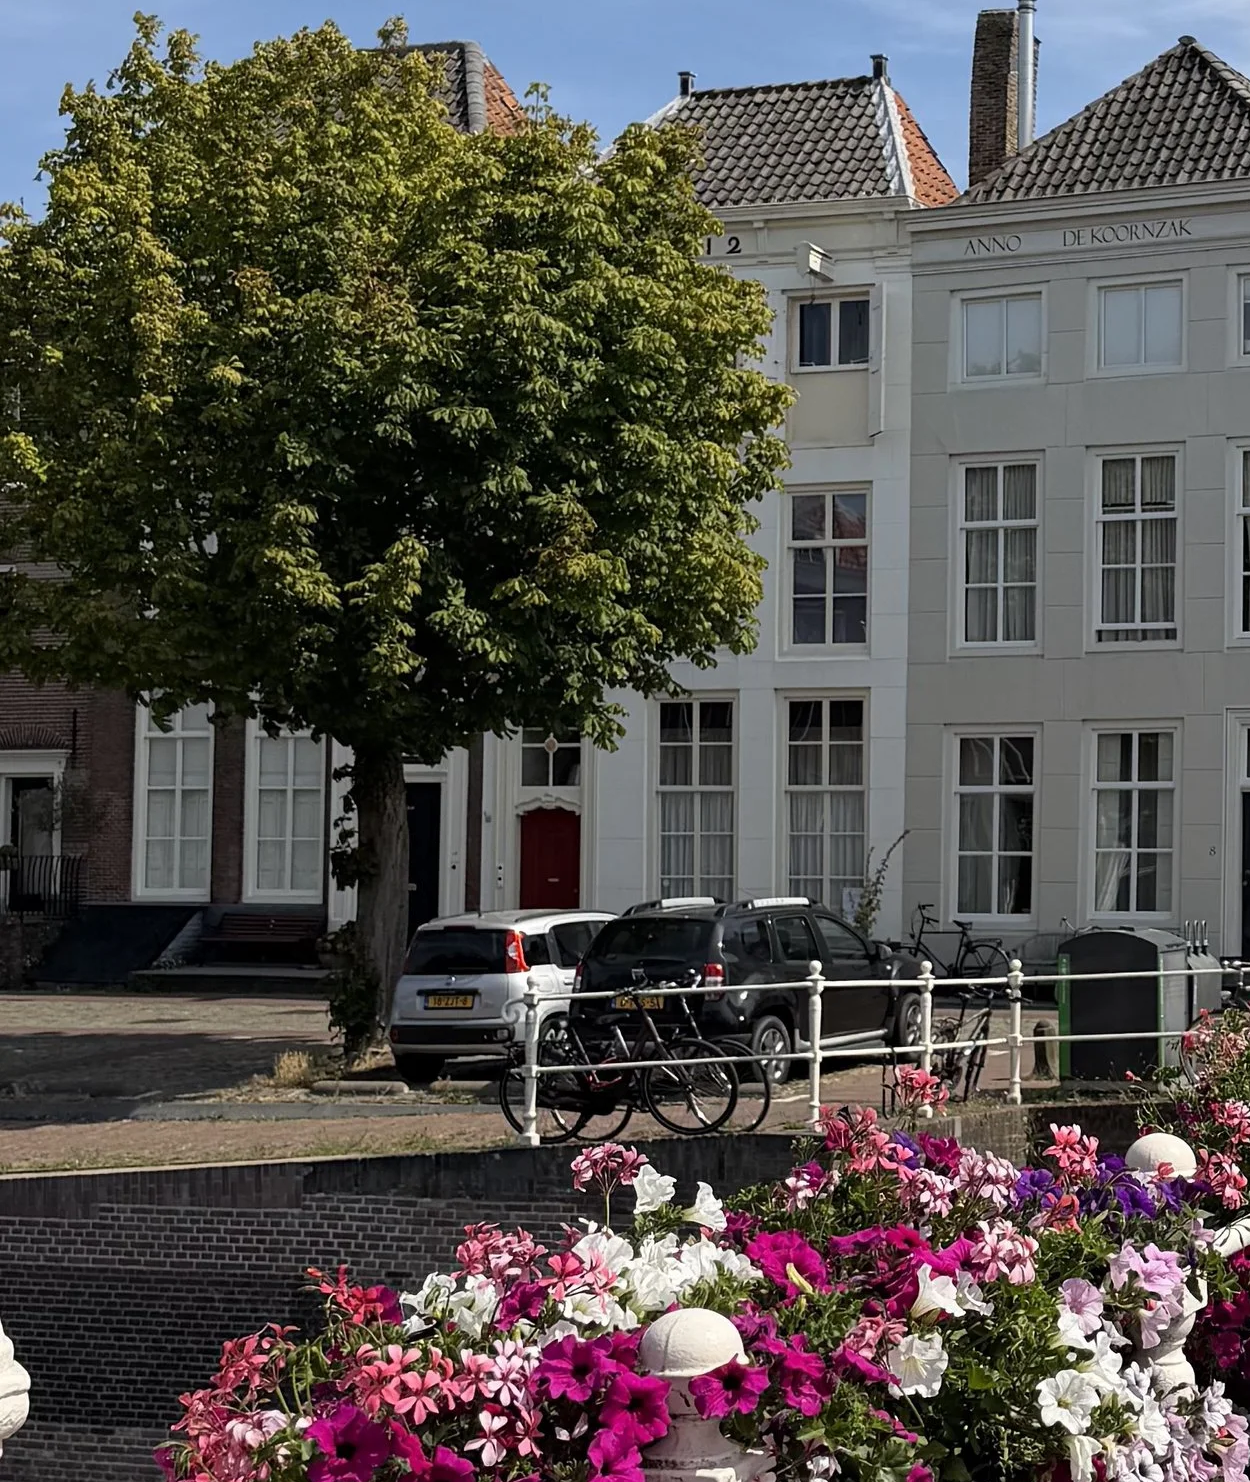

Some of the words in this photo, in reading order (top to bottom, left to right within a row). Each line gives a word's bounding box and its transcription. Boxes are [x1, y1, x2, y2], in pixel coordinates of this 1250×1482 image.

[964, 235, 1022, 256] ANNO
[1062, 229, 1086, 247] DE
[1090, 219, 1192, 244] KOORNZAK
[1209, 846, 1216, 856] 8
